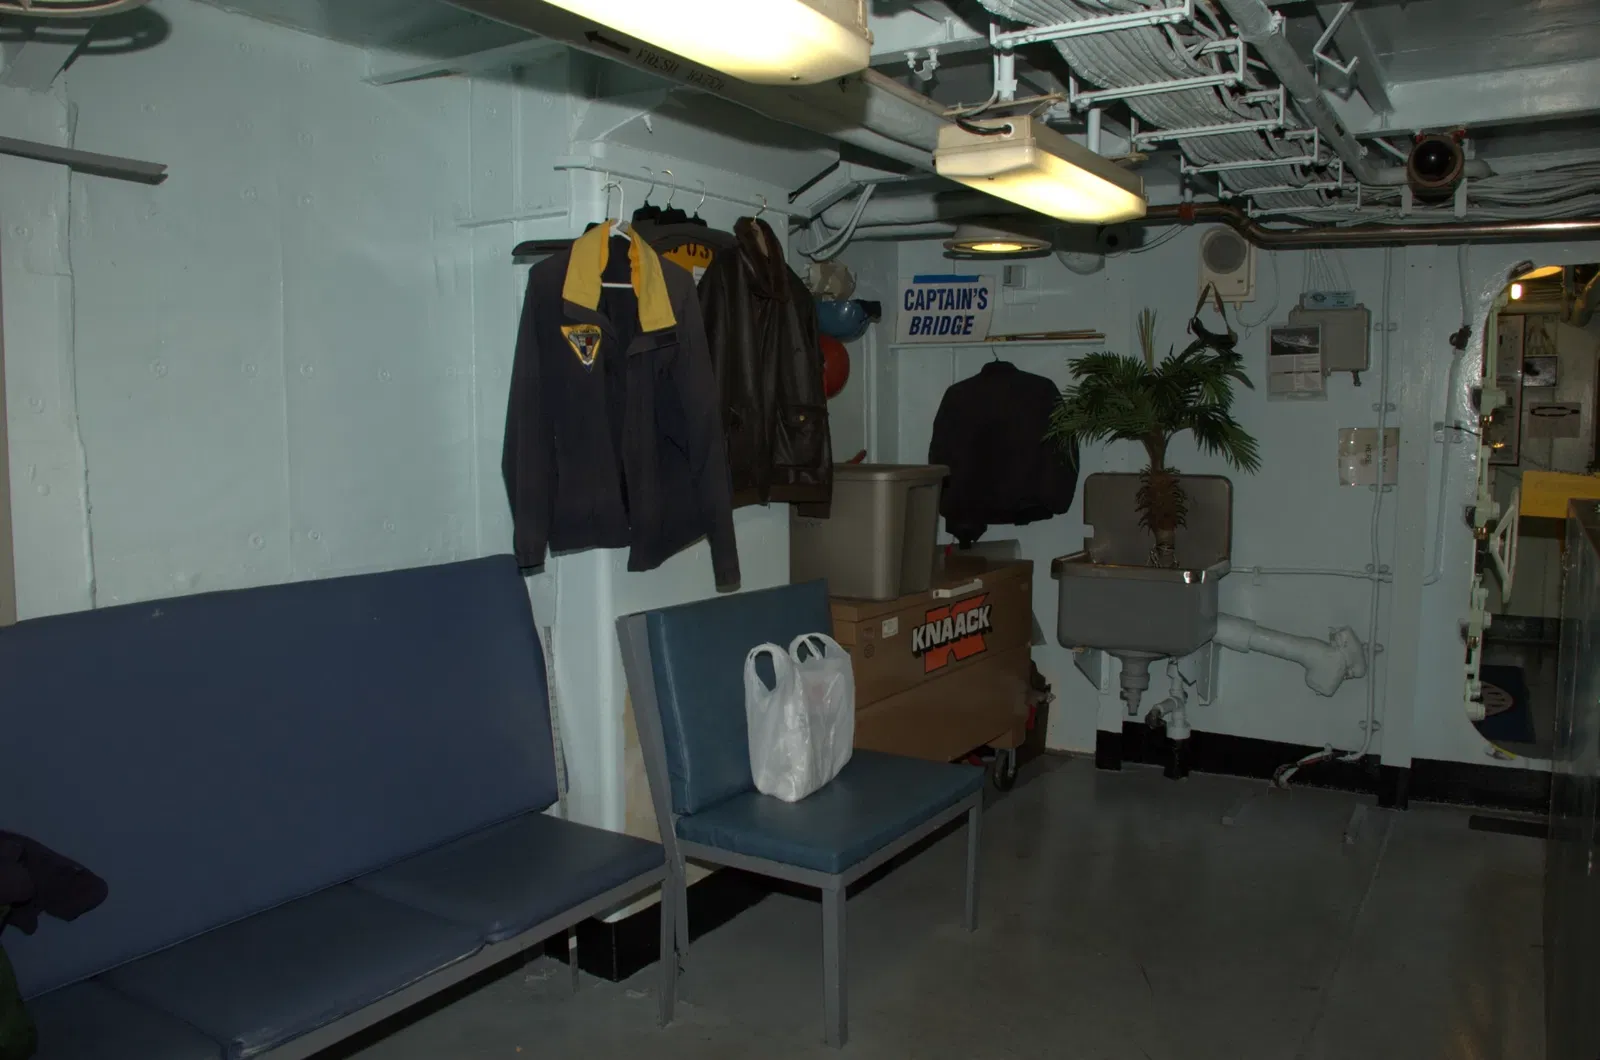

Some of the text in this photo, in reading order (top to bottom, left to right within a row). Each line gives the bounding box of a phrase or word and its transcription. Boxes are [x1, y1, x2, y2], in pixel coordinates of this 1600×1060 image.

[636, 47, 680, 74] FRESH
[904, 287, 988, 311] CAPTAIN'S
[909, 315, 975, 336] BRIDGE
[911, 604, 993, 658] KNAACK
